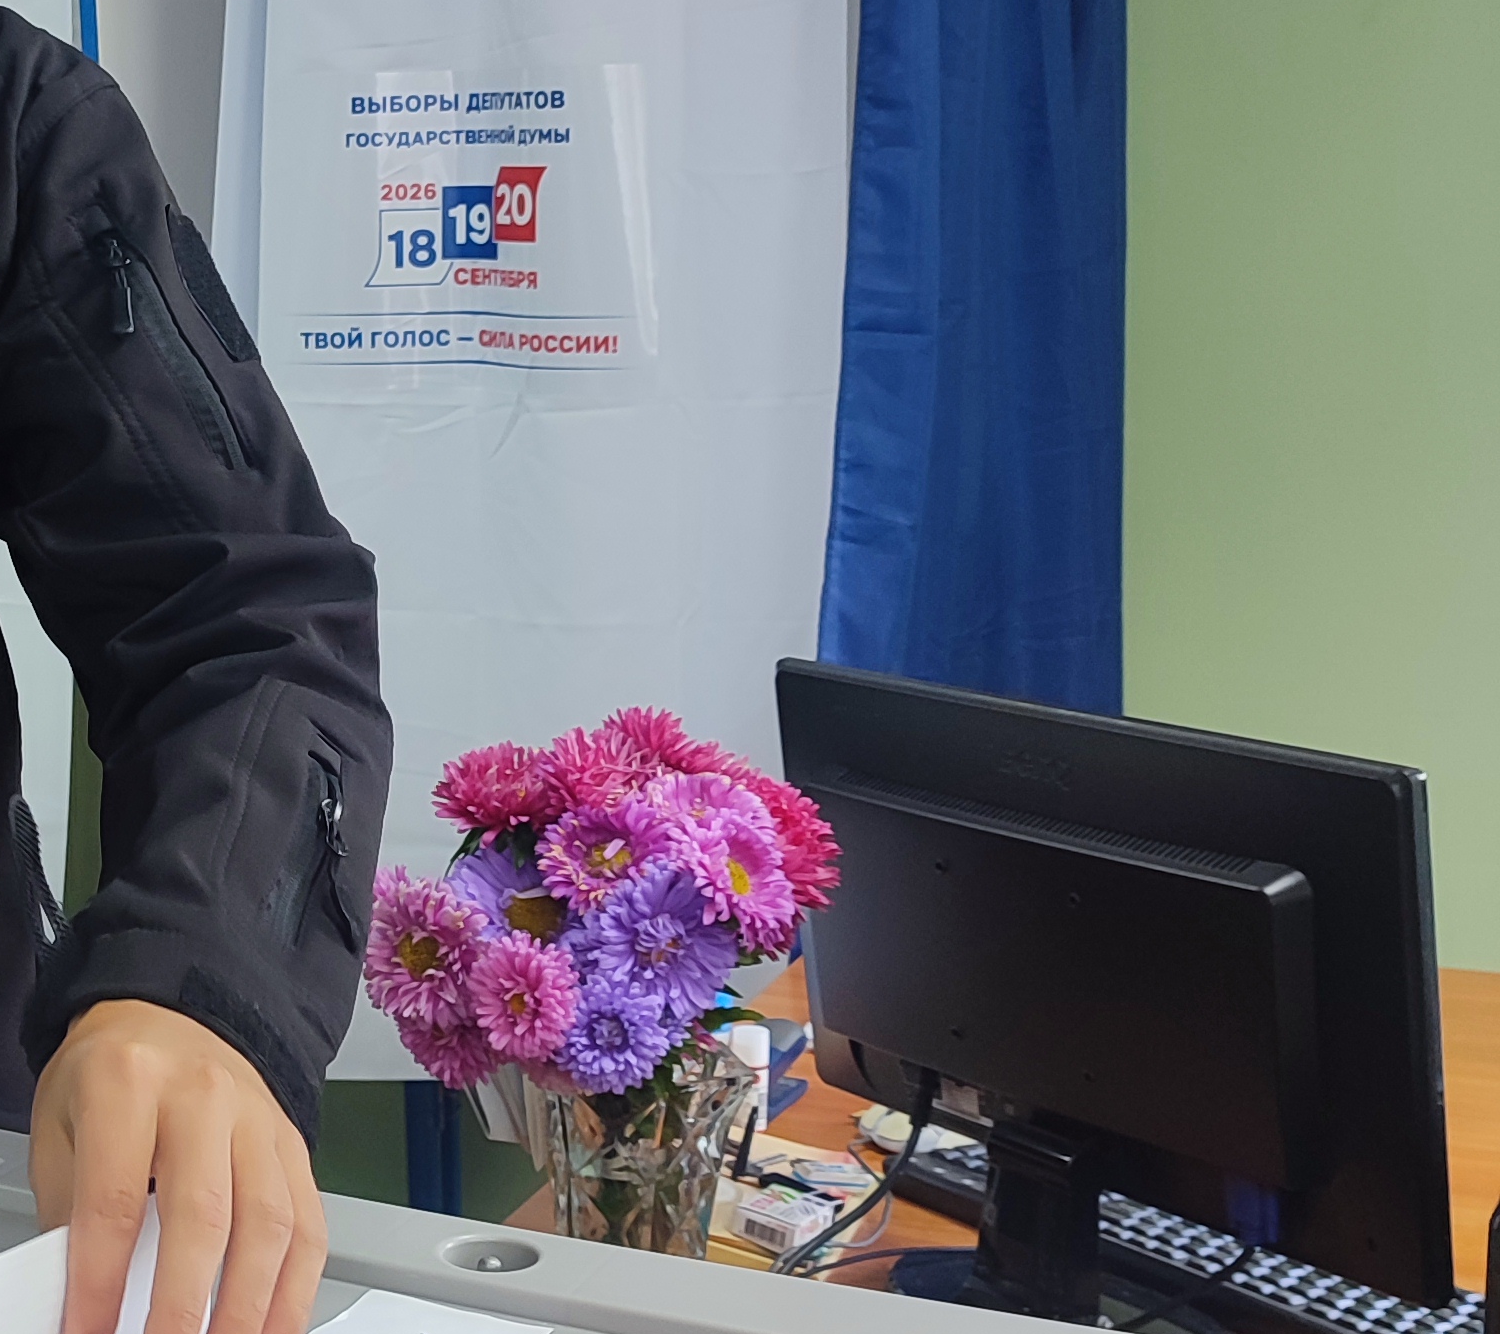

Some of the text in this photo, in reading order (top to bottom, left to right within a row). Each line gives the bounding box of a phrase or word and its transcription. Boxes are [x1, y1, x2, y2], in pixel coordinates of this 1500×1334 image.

[351, 90, 565, 115] ВЫБОРЫ ДЕПУТАТОВ
[345, 125, 571, 148] ГОСУДАРСТВЕННОЙ ДУМЫ
[380, 183, 436, 201] 2026
[387, 183, 534, 269] 18 19 20
[453, 267, 538, 290] СЕНТЯБРЯ
[299, 327, 363, 350] ТВОЙ
[370, 329, 451, 348] ГОЛОС
[519, 333, 618, 354] РОССИИ!
